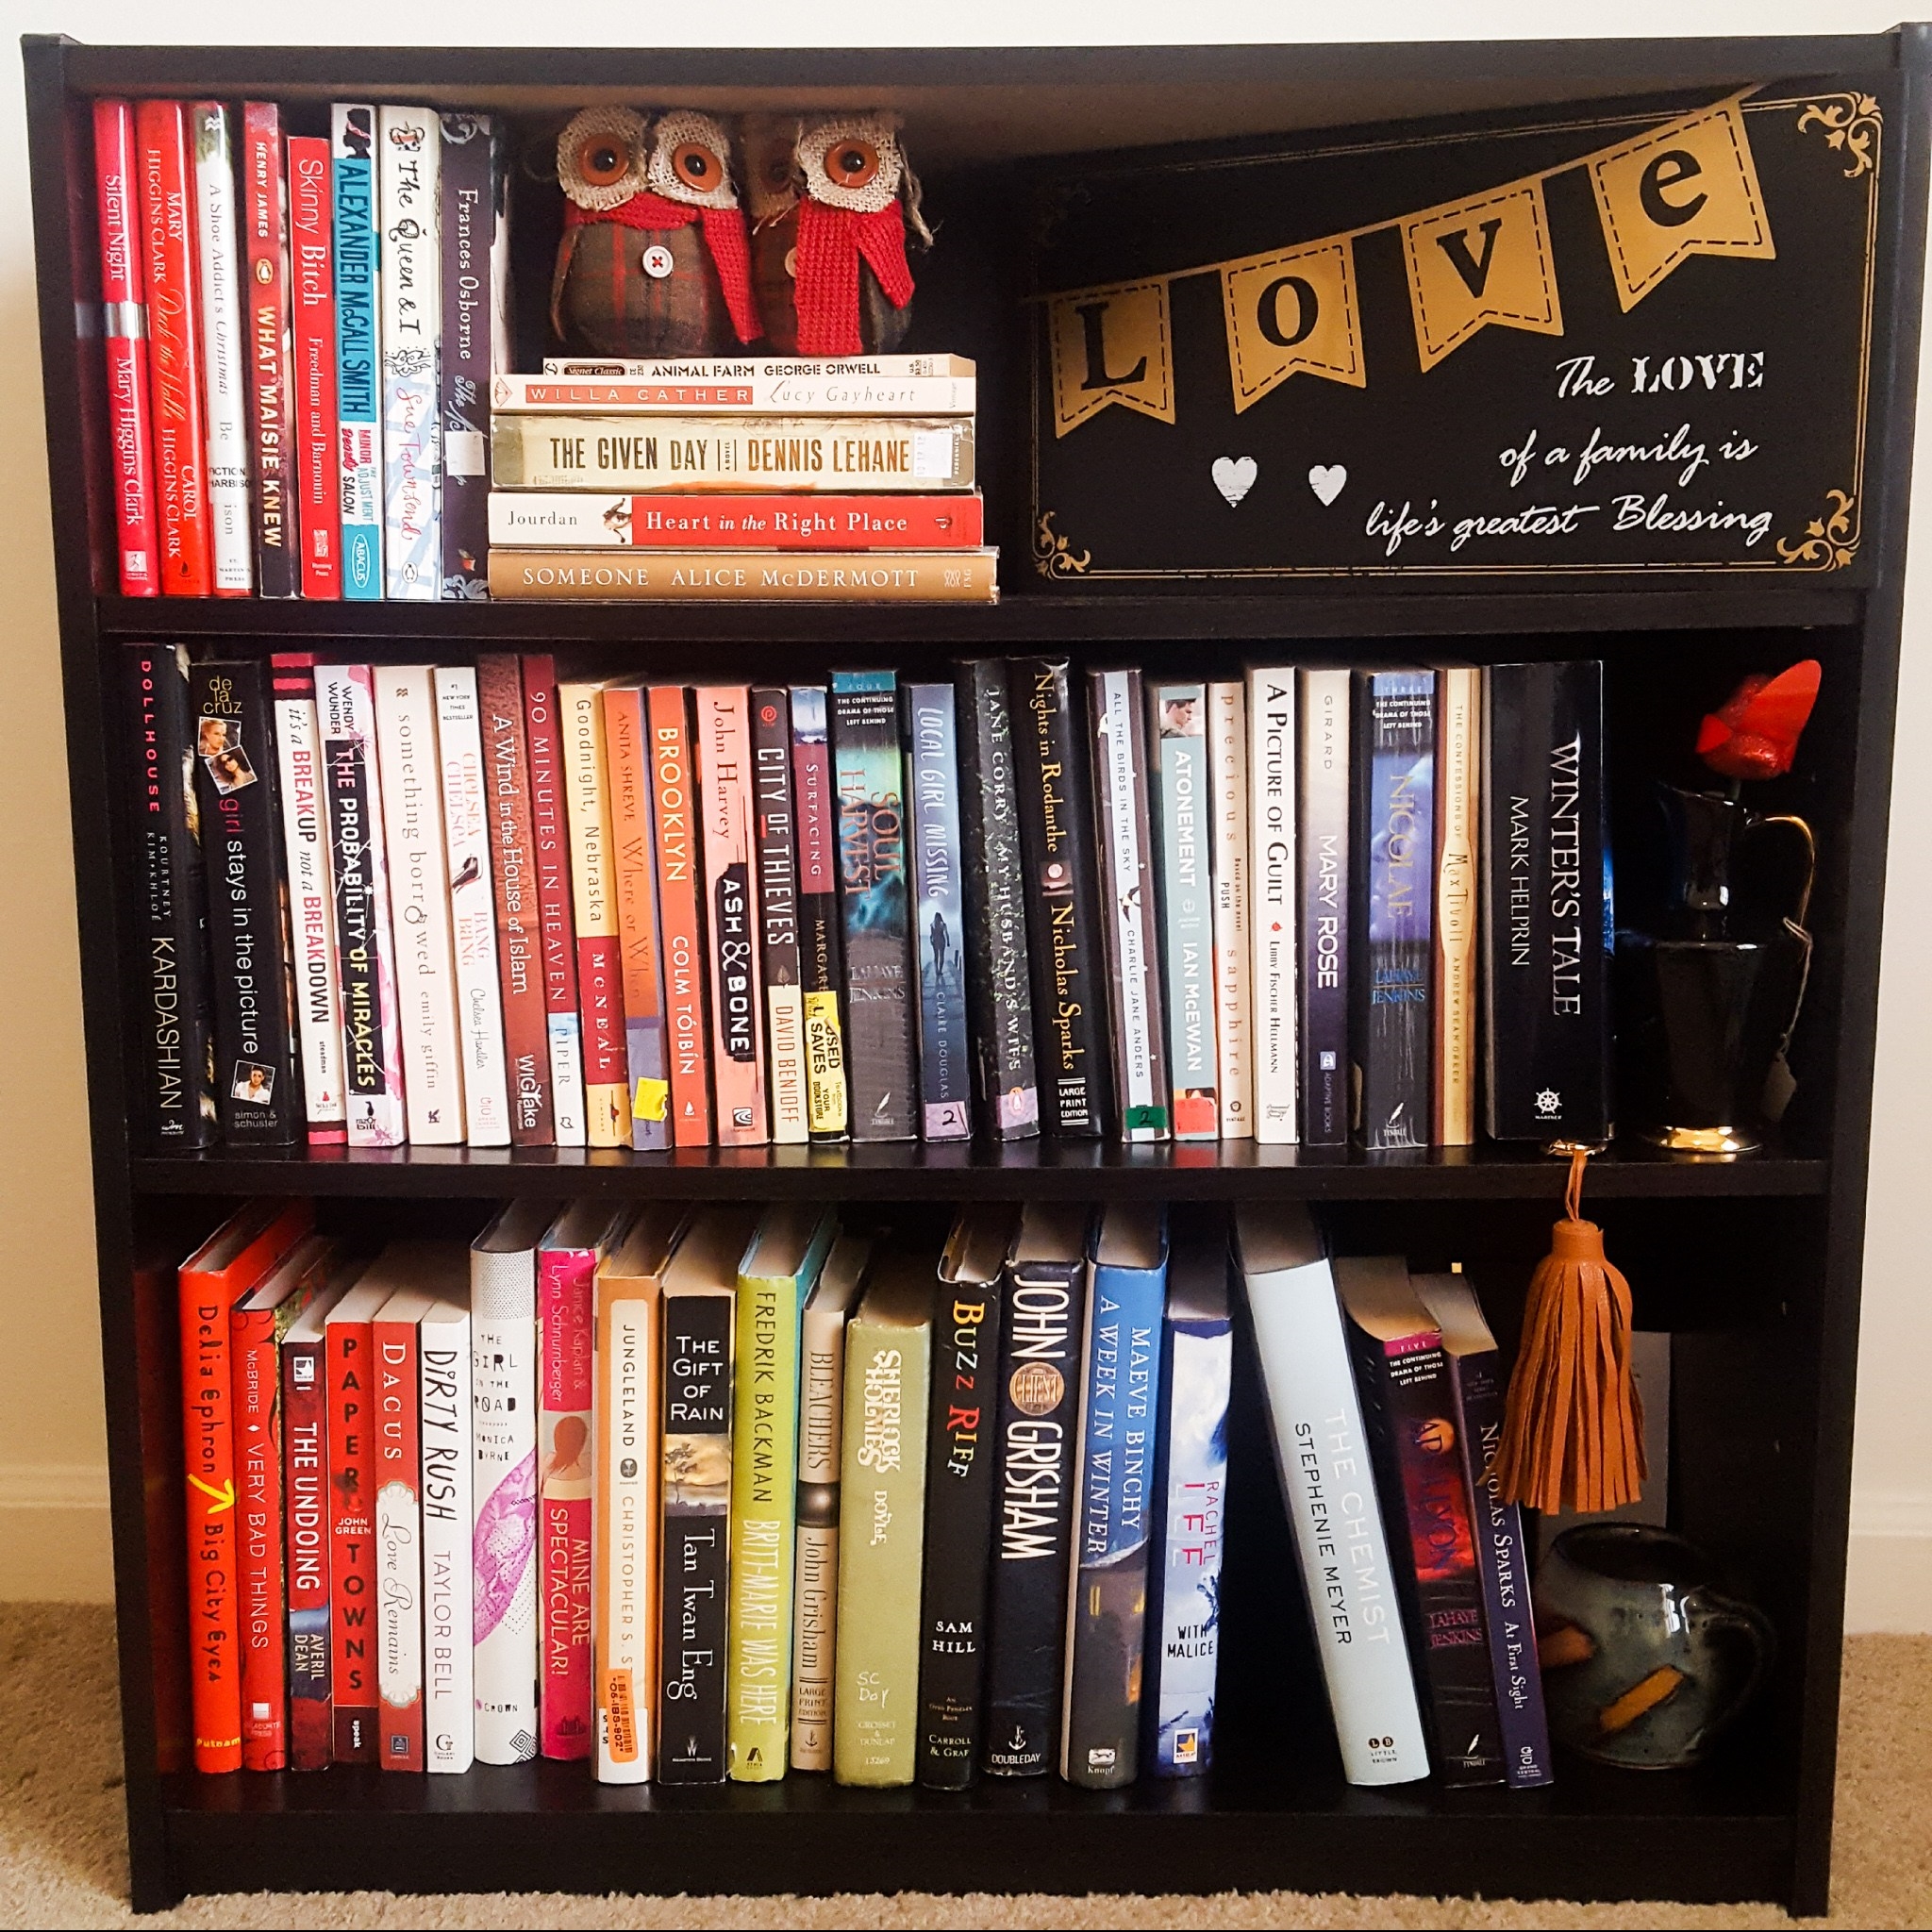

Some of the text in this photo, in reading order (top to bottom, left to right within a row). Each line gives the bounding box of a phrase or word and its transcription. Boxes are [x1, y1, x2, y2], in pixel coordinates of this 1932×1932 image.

[147, 149, 167, 283] HIGGINS CLARK
[256, 142, 269, 238] HENRY JAMES
[296, 158, 327, 307] Skinny Bitch
[338, 164, 371, 414] ALEXANDER McCALL SMITH
[458, 189, 480, 360] Frances Osborne
[308, 337, 327, 506] Freedman and Barnouin
[531, 389, 749, 402] WILLA CATHER
[652, 364, 709, 376] ANIMAL
[714, 364, 755, 377] FARM
[764, 363, 880, 376] GEORGE ORWELL
[770, 379, 915, 404] Lucy Gayheart
[1556, 351, 1764, 398] The LOVE
[162, 428, 181, 558] HIGGINS CLARK
[181, 465, 197, 521] CAROL
[550, 437, 708, 471] THE GIVEN DAY
[748, 439, 824, 472] DENNIS
[833, 440, 910, 473] LEHANE
[1499, 423, 1758, 487] of a family is
[508, 510, 578, 525] Jourdan
[646, 511, 908, 537] Heart in the Right Place
[1366, 494, 1774, 556] life's greatest Blessing
[523, 568, 650, 586] SOMEONE
[671, 569, 747, 587] ALICE
[142, 661, 159, 812] DOLLHOUSE
[204, 701, 242, 714] cruz
[328, 682, 341, 734] WUNDER
[342, 687, 355, 731] WENDY
[1324, 695, 1332, 770] GIRARD
[576, 700, 605, 922] Goodnight, Nebraska
[658, 727, 688, 881] BROOKLYN
[713, 702, 738, 839] John Harvey
[806, 764, 821, 876] SURFACING
[918, 708, 949, 897] LOCAL GIRL MISSING
[1176, 750, 1195, 887] ATONEMENT
[1221, 695, 1239, 841] precious
[1267, 684, 1288, 905] A PICTURE OF GUILT
[758, 749, 793, 945] CITY OF THIEVES
[1221, 882, 1229, 908] PUSH
[1510, 796, 1530, 966] MARK HELPRIN
[1551, 729, 1581, 1015] WINTER'S TALE
[220, 799, 258, 1054] girl stays in the picture
[722, 879, 750, 1051] ASH & BONE
[1318, 835, 1338, 989] MARY ROSE
[151, 938, 182, 1108] KARDASHIAN
[673, 937, 698, 1074] COLM TÓIBÍN
[1051, 902, 1084, 1070] Nicholas Sparks
[1127, 930, 1143, 1078] CHARLIE JANE ANDERS
[1225, 950, 1242, 1076] sapphire
[556, 1029, 571, 1085] PIPER
[775, 1006, 798, 1123] DAVID BENIOFF
[811, 1024, 826, 1074] SAVES
[937, 992, 950, 1098] CLAIRE DOUGLAS
[1058, 1087, 1086, 1096] LARGE
[942, 1110, 957, 1125] 2
[1060, 1098, 1087, 1108] PRINT
[1139, 1110, 1152, 1124] 2
[382, 1342, 406, 1459] DACUS
[623, 1324, 636, 1447] JUNGLELAND
[684, 1385, 711, 1398] OF
[753, 1291, 775, 1503] FREDRIK BACKMAN
[808, 1352, 833, 1469] BLEACHERS
[1002, 1274, 1070, 1559] JOHN GRISHAM
[1088, 1295, 1121, 1554] A WEEK IN WINTER
[1121, 1327, 1151, 1530] MAEVE BINCHY
[293, 1422, 320, 1591] THE UNDOING
[478, 1451, 509, 1461] BYRNE
[335, 1526, 371, 1535] GREEN
[740, 1520, 781, 1630] BRITT-MARIE
[1203, 1481, 1219, 1565] RACHEL
[1295, 1423, 1352, 1644] STEPHENIE MEYER
[1324, 1408, 1391, 1644] THE CHEMIST
[433, 1551, 452, 1700] TAYLOR BELL
[550, 1509, 569, 1676] SPECTACULAR!
[666, 1528, 715, 1700] Tan Twan Eng
[802, 1537, 831, 1669] John Grisham
[932, 1640, 976, 1653] HILL
[936, 1621, 973, 1633] SAM
[294, 1635, 308, 1672] DEAN
[310, 1634, 325, 1681] AVERIL
[740, 1684, 776, 1725] HERE
[741, 1641, 777, 1678] WAS
[1167, 1641, 1214, 1657] MALICE
[928, 1734, 972, 1745] CARROLL
[991, 1753, 1041, 1764] DOUBLEDAY
[1087, 1765, 1115, 1775] Knopf
